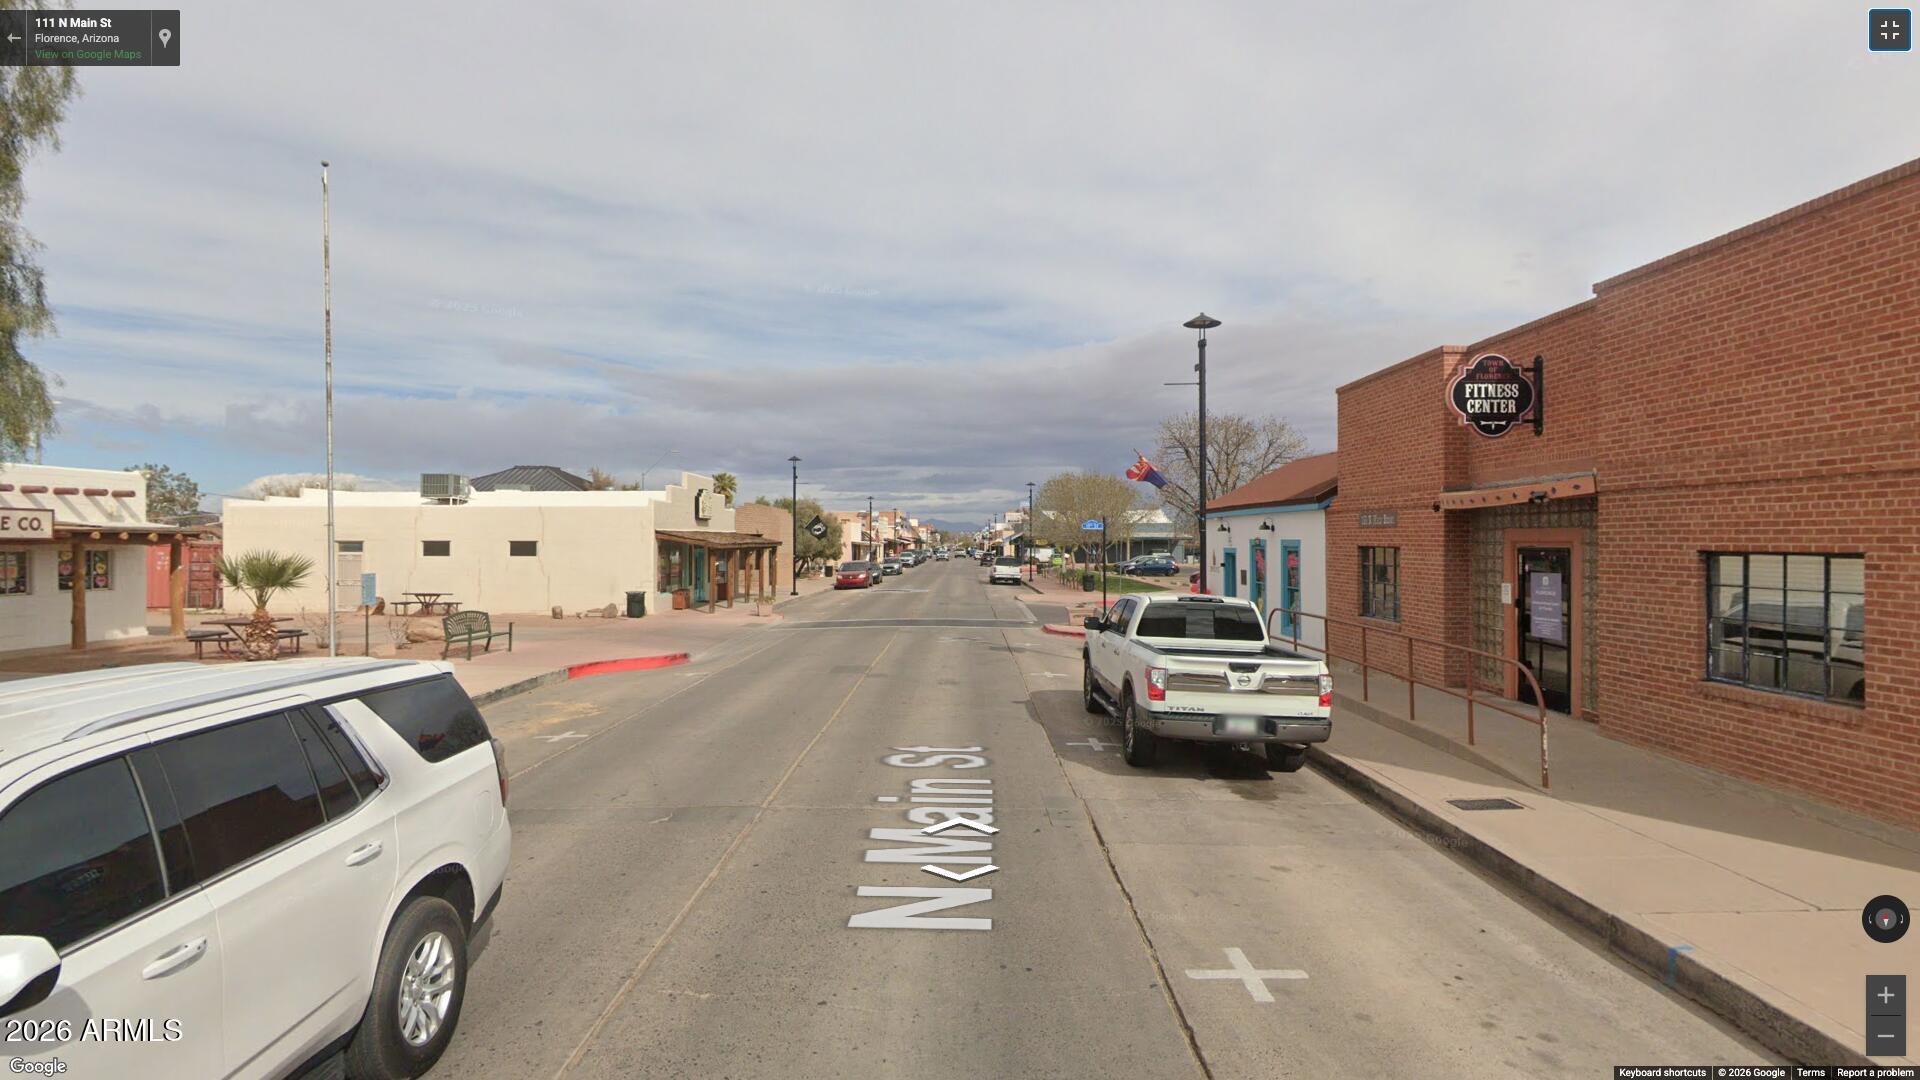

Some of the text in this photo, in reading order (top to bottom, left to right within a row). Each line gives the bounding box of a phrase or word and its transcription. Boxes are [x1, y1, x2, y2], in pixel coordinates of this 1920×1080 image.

[1465, 383, 1519, 398] FITNESS
[1466, 399, 1517, 413] CENTER
[18, 517, 44, 532] CO.
